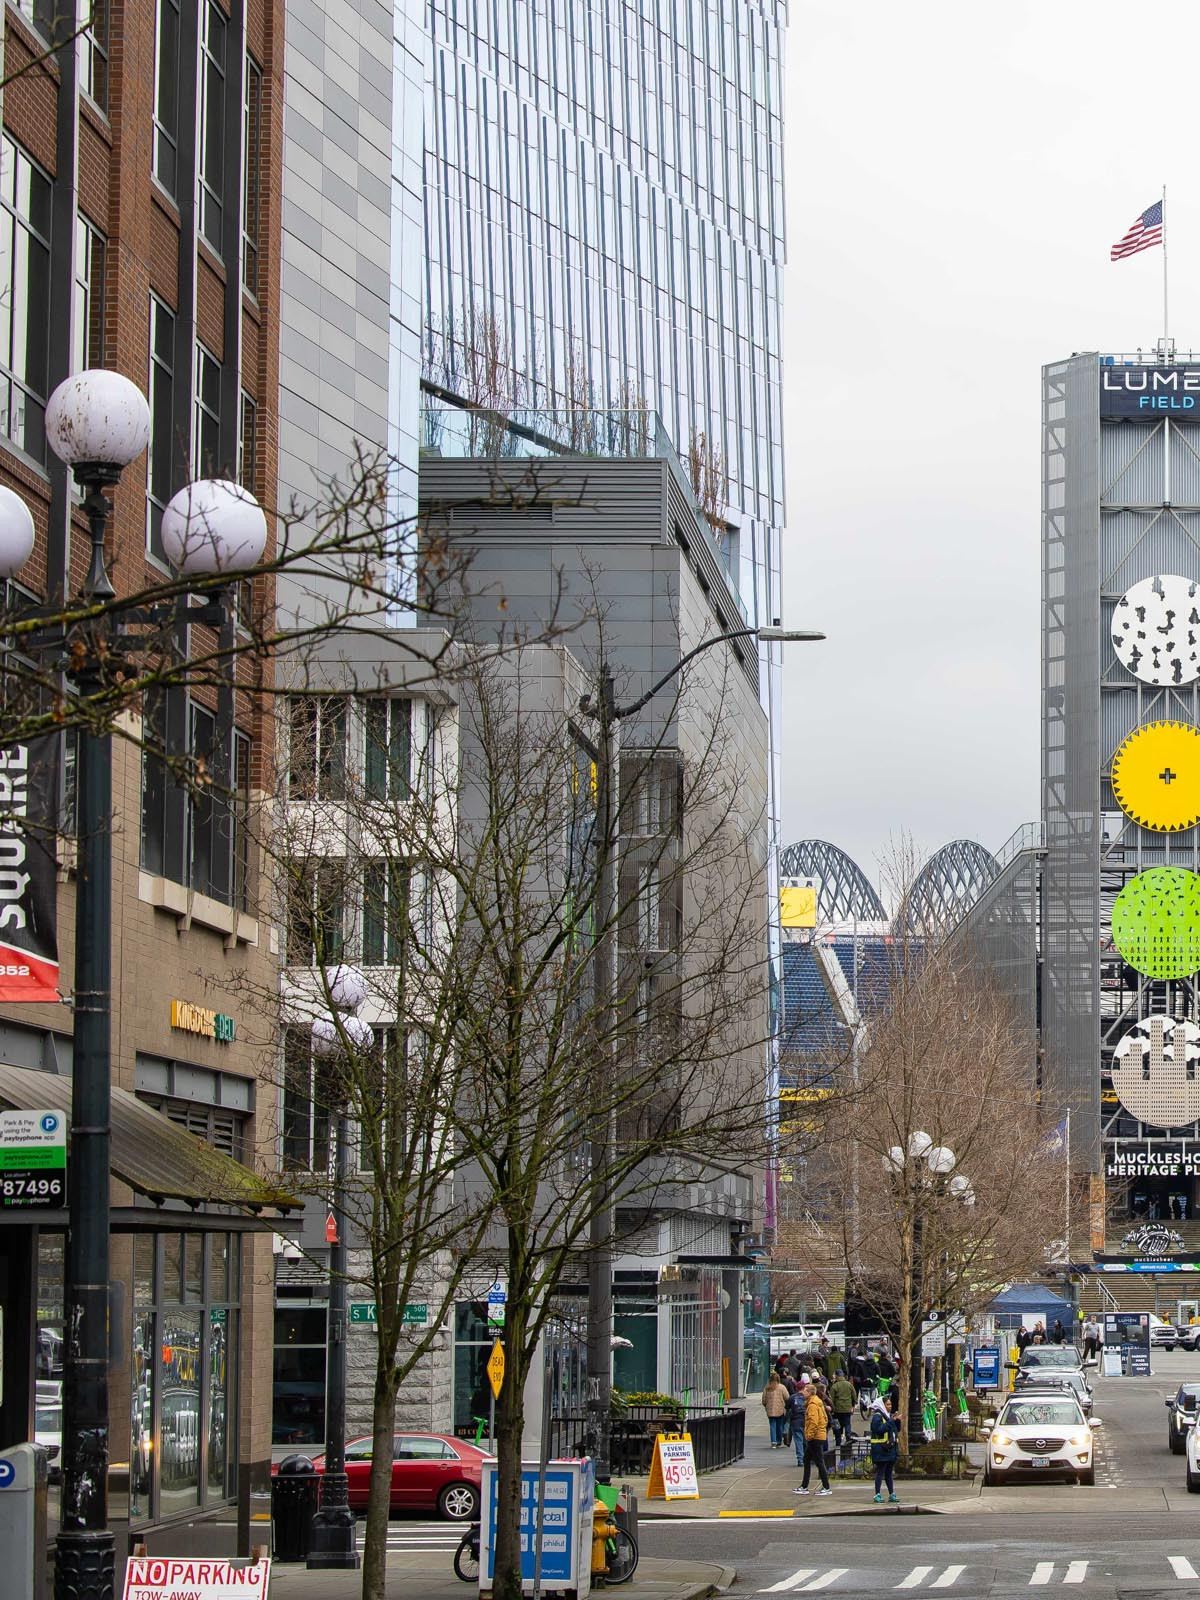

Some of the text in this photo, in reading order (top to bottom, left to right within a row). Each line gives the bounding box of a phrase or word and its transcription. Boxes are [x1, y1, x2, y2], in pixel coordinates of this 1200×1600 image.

[1139, 396, 1195, 408] FIELD
[1108, 1165, 1178, 1176] HERITAGE
[3, 1180, 61, 1196] 87496
[353, 1310, 360, 1319] S
[492, 1356, 503, 1366] DEAD
[493, 1371, 501, 1382] END
[130, 1560, 260, 1585] NO PARKING
[134, 1591, 202, 1600] TOW-AWAY
